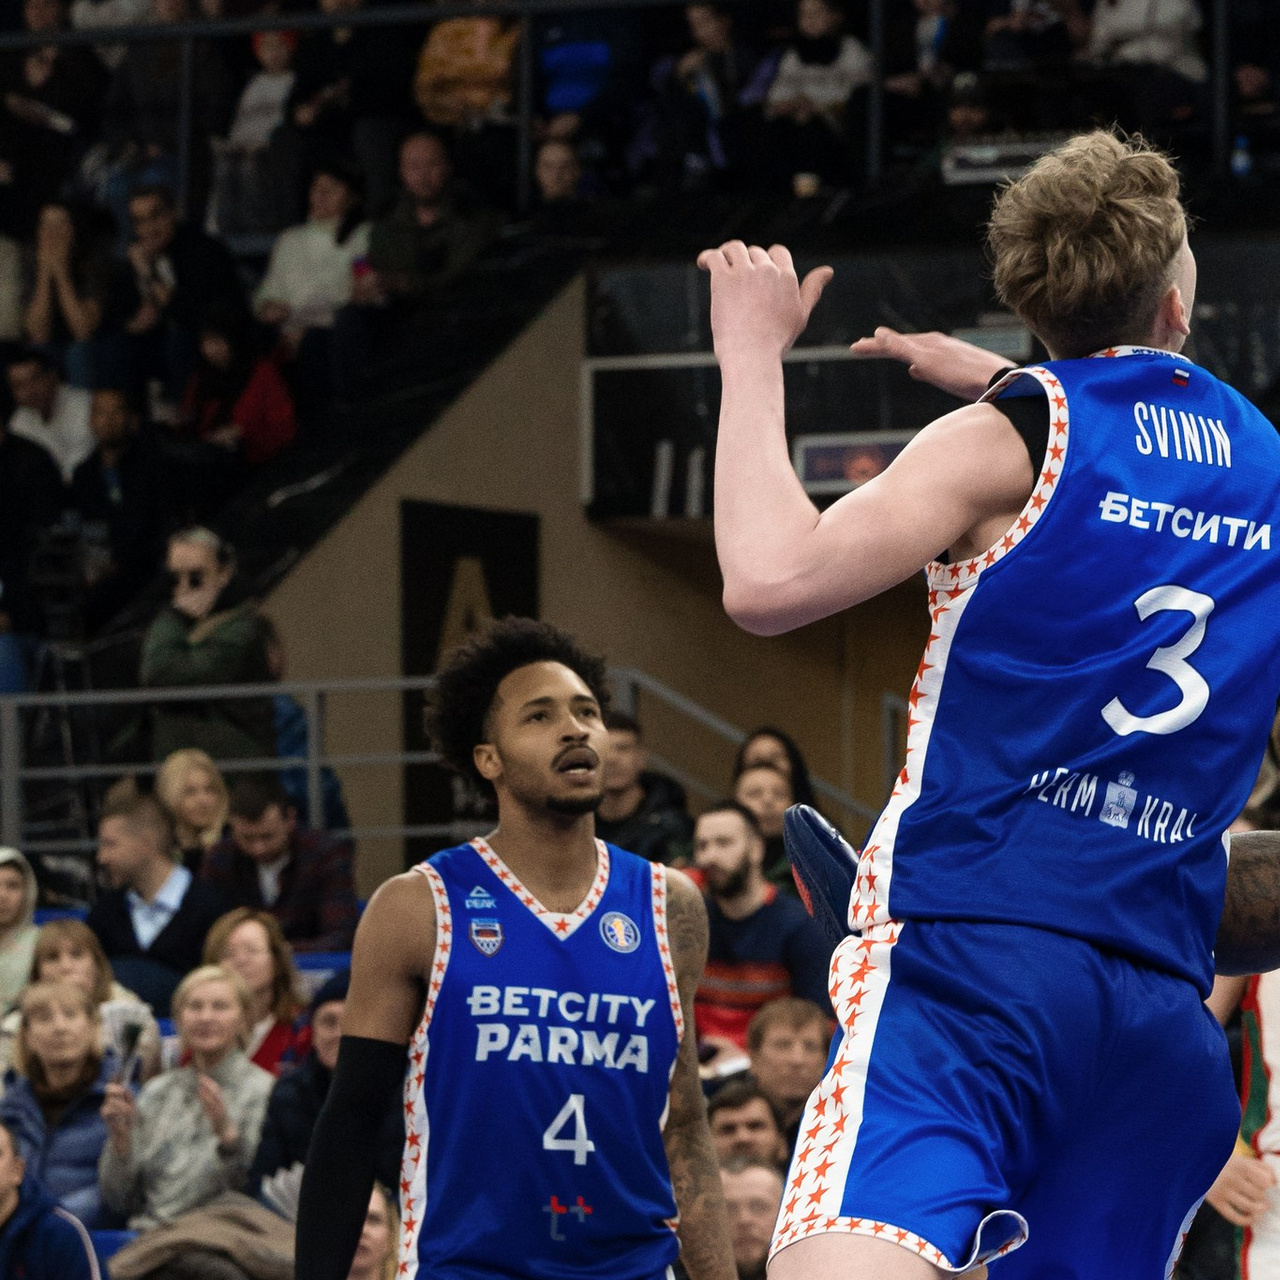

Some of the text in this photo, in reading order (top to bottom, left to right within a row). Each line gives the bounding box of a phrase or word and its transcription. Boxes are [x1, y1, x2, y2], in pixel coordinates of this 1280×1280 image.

[1134, 402, 1232, 468] SVININ
[1099, 491, 1271, 550] БЕТСИТИ
[1101, 584, 1215, 736] 3
[467, 985, 656, 1027] BETCITY
[475, 1023, 649, 1073] PARMA
[543, 1094, 595, 1165] 4
